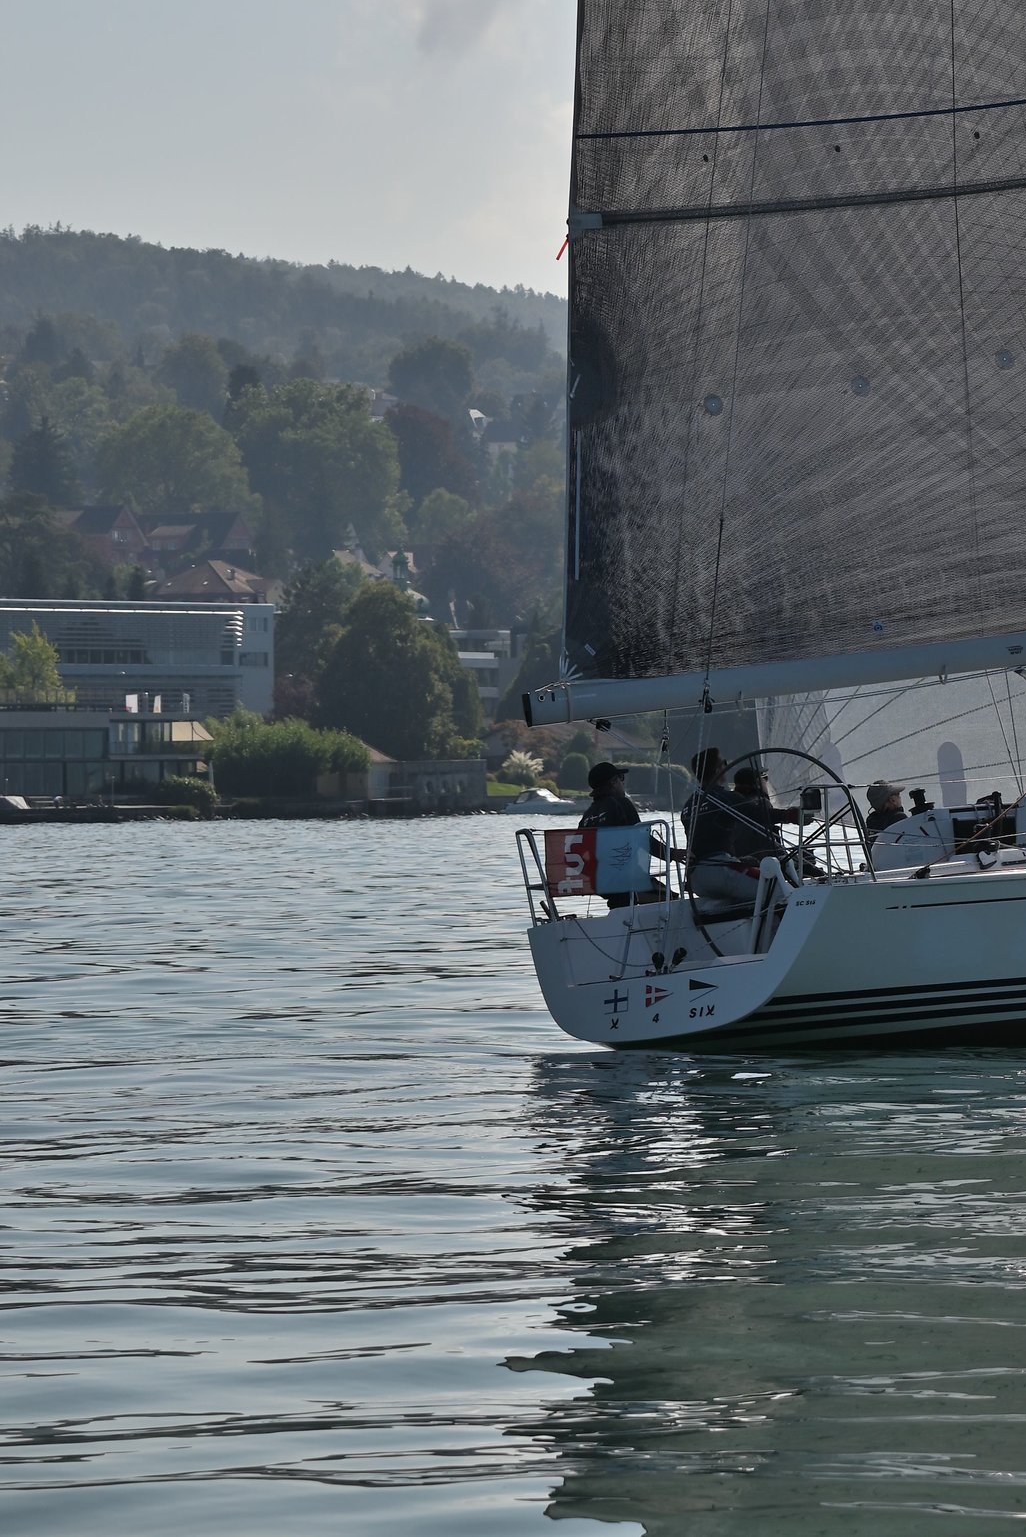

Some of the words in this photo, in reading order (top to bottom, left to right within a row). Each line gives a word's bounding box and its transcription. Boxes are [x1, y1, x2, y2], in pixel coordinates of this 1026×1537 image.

[610, 1018, 619, 1030] X
[652, 1013, 660, 1023] 4
[689, 1004, 715, 1018] SIX
